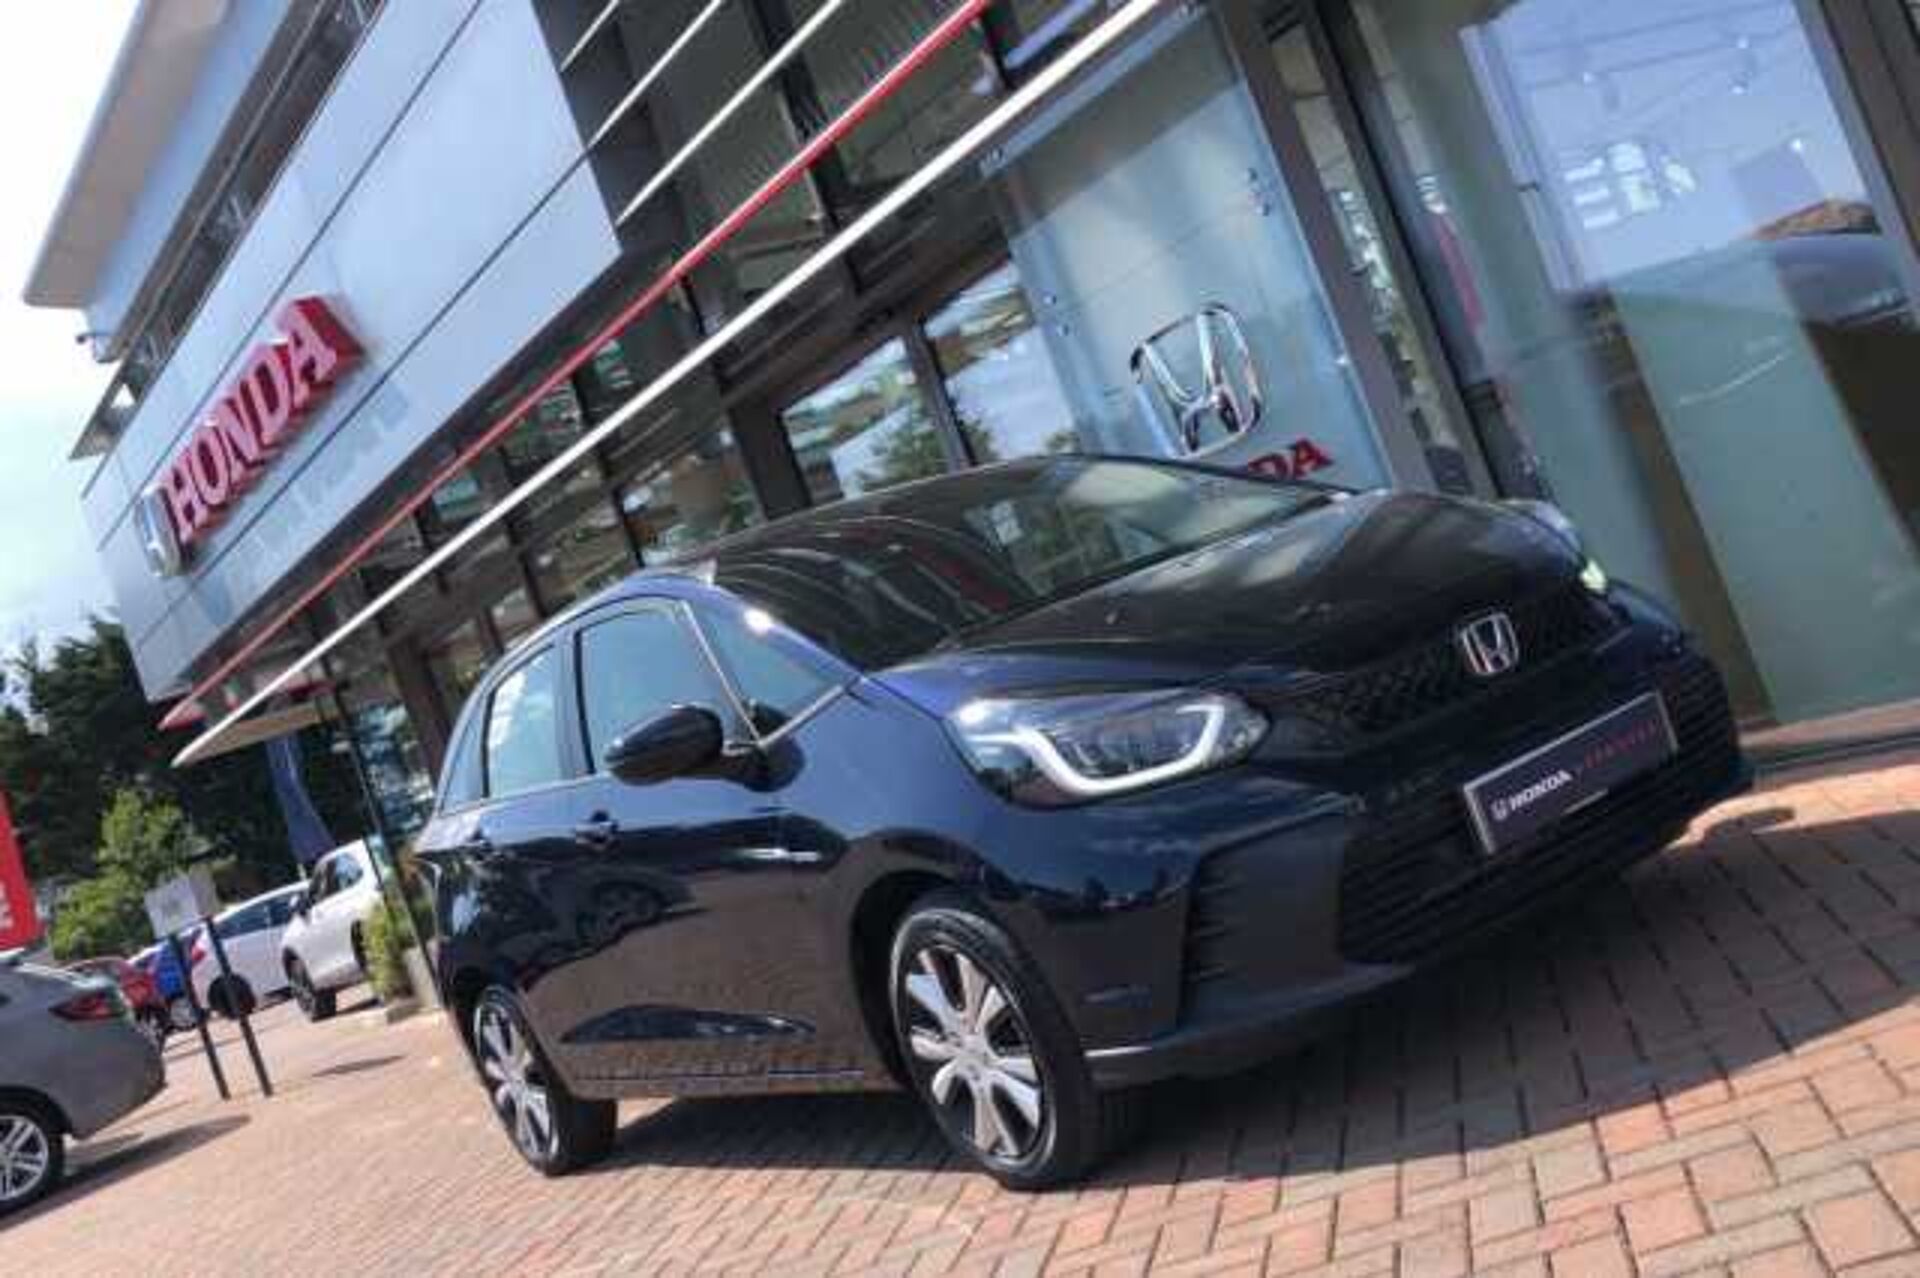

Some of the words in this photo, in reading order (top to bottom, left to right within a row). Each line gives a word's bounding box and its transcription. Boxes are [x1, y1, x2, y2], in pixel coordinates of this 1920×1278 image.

[160, 296, 362, 545] HONDA
[1247, 437, 1333, 479] DA
[1509, 769, 1572, 811] HONDA
